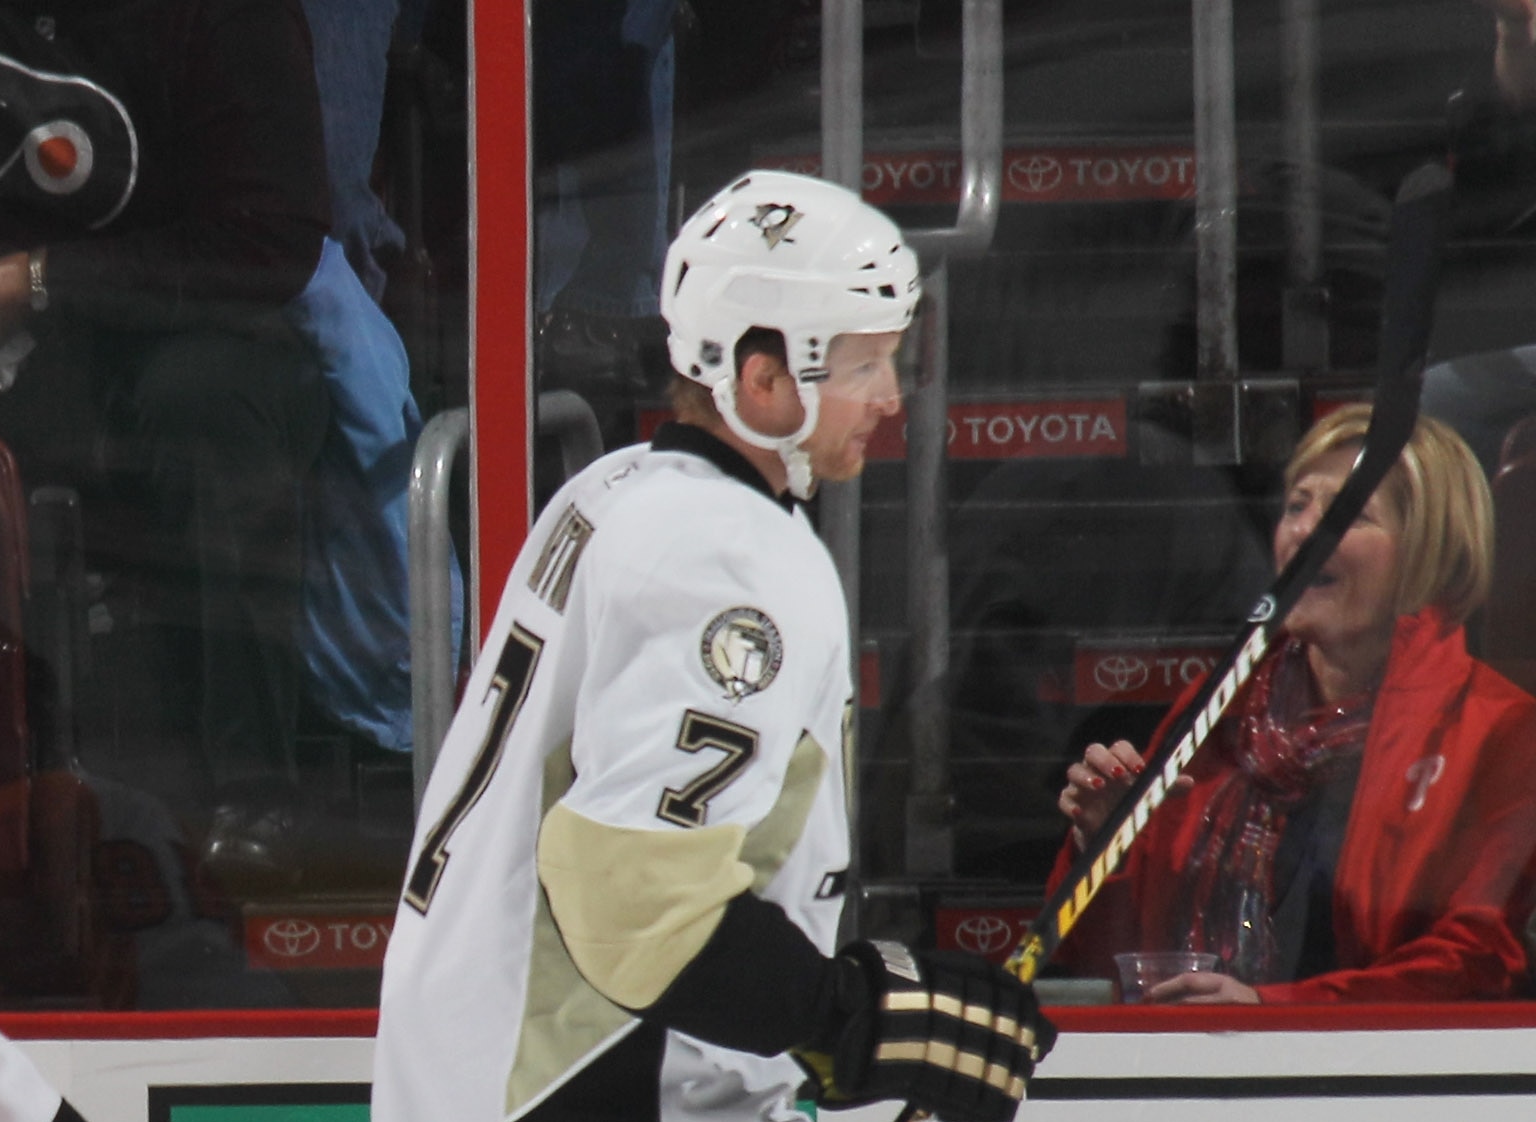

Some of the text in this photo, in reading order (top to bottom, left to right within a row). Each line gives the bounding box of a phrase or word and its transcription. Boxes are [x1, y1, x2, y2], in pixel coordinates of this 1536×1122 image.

[864, 161, 961, 191] OYOT
[1070, 157, 1195, 186] TOYOT
[963, 413, 1117, 445] TOYOTA
[1156, 656, 1216, 687] TO
[657, 708, 760, 829] 7
[1058, 625, 1269, 938] WARRIOR
